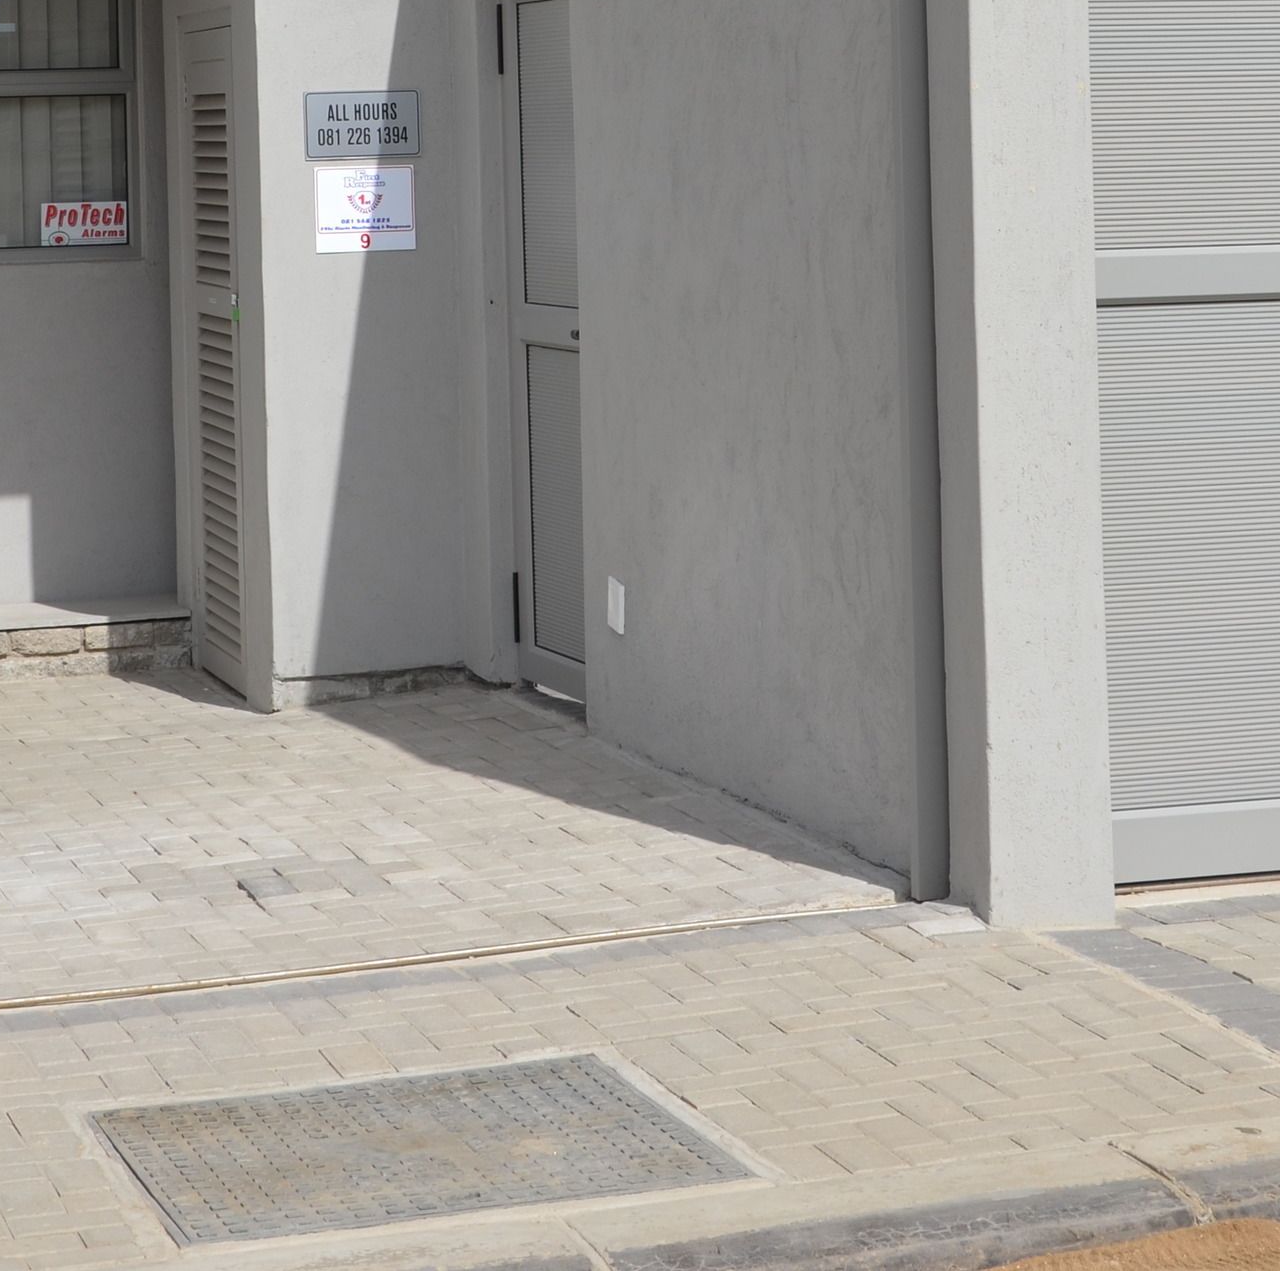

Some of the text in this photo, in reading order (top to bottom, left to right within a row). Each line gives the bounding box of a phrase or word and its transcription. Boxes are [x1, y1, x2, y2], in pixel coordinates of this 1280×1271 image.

[327, 102, 398, 122] ALL HOURS
[317, 126, 409, 146] 081 226 1394
[45, 202, 125, 227] ProTech
[81, 229, 125, 238] Alarms
[360, 233, 371, 249] 9
